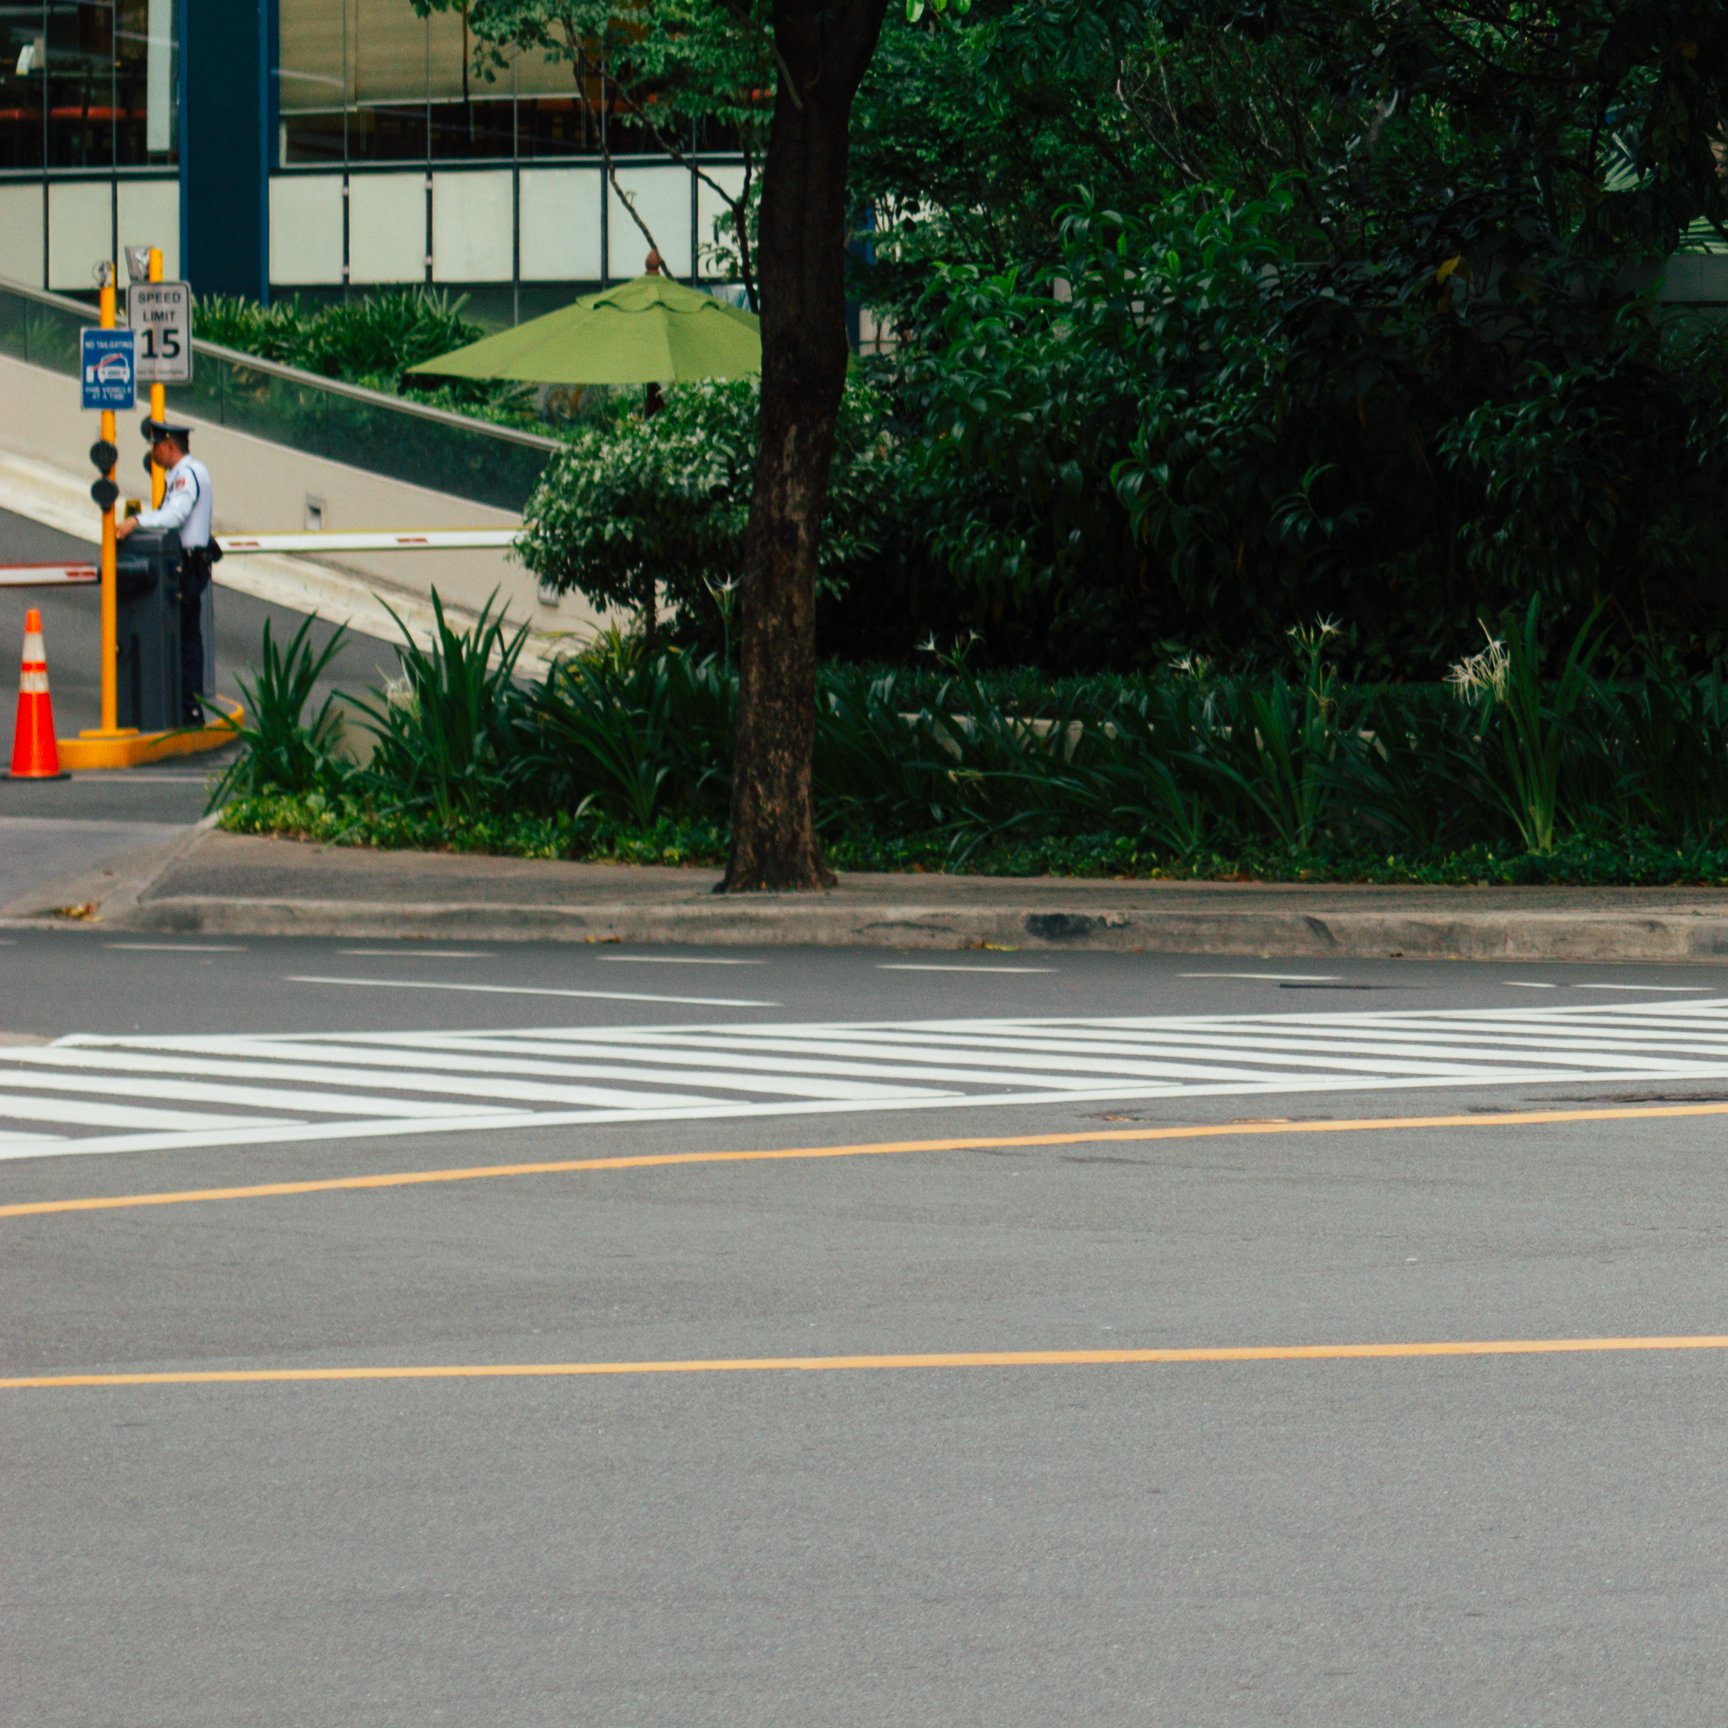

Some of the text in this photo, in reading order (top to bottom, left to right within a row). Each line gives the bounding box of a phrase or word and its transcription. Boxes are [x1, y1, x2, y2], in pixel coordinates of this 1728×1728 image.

[138, 292, 181, 303] SPEED
[143, 310, 175, 322] LIMIT
[85, 340, 95, 349] NO
[141, 328, 181, 359] 15
